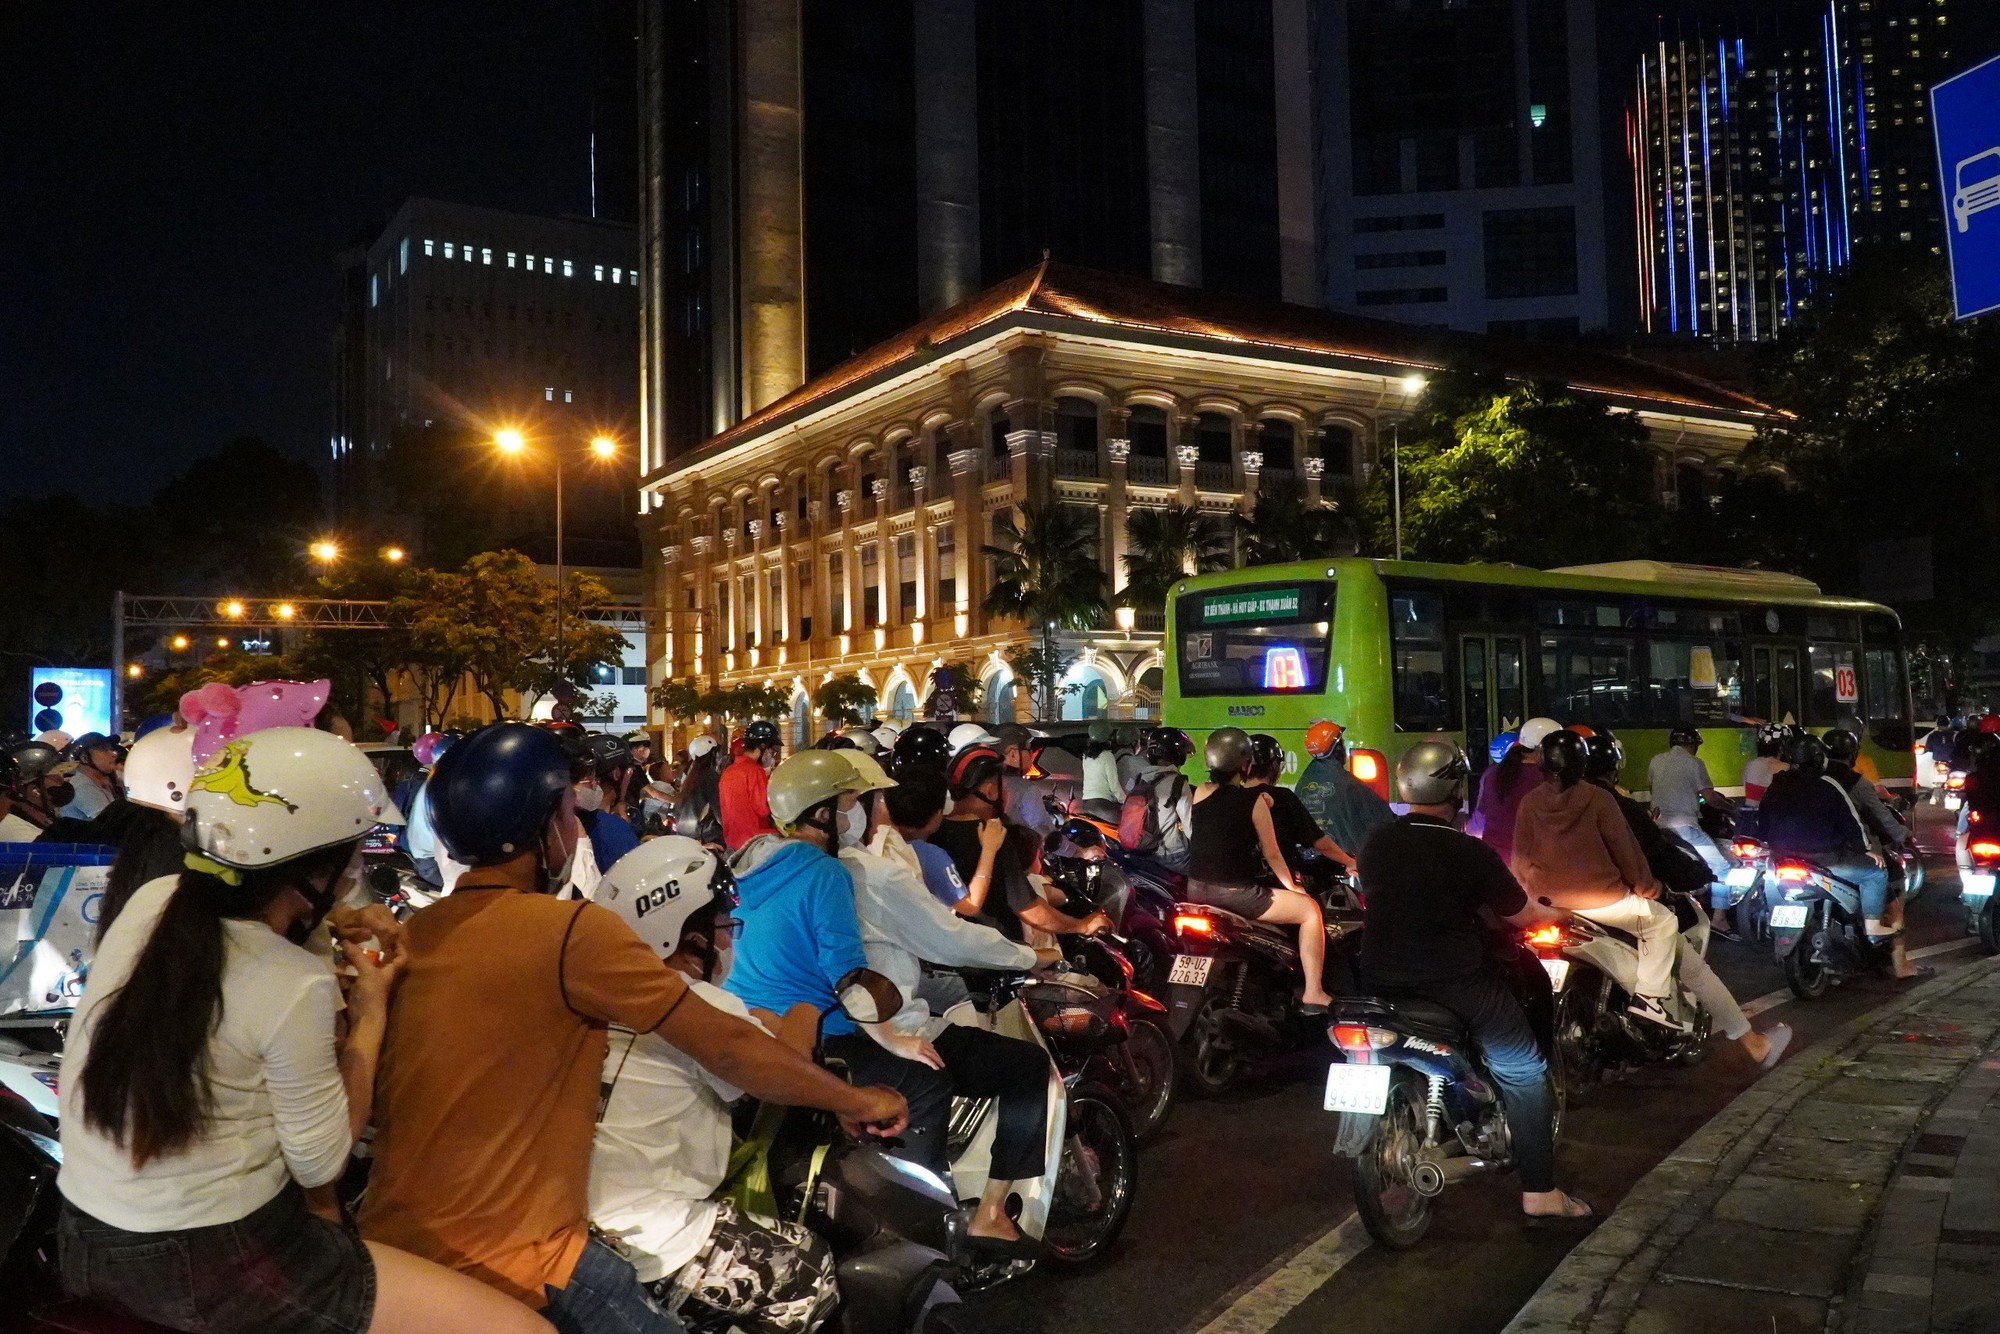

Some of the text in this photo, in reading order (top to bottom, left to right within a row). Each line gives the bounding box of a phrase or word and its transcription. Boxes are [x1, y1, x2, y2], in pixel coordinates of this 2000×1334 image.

[1837, 669, 1856, 698] 03
[1178, 956, 1207, 971] 59-U2
[1170, 970, 1206, 985] 226.33
